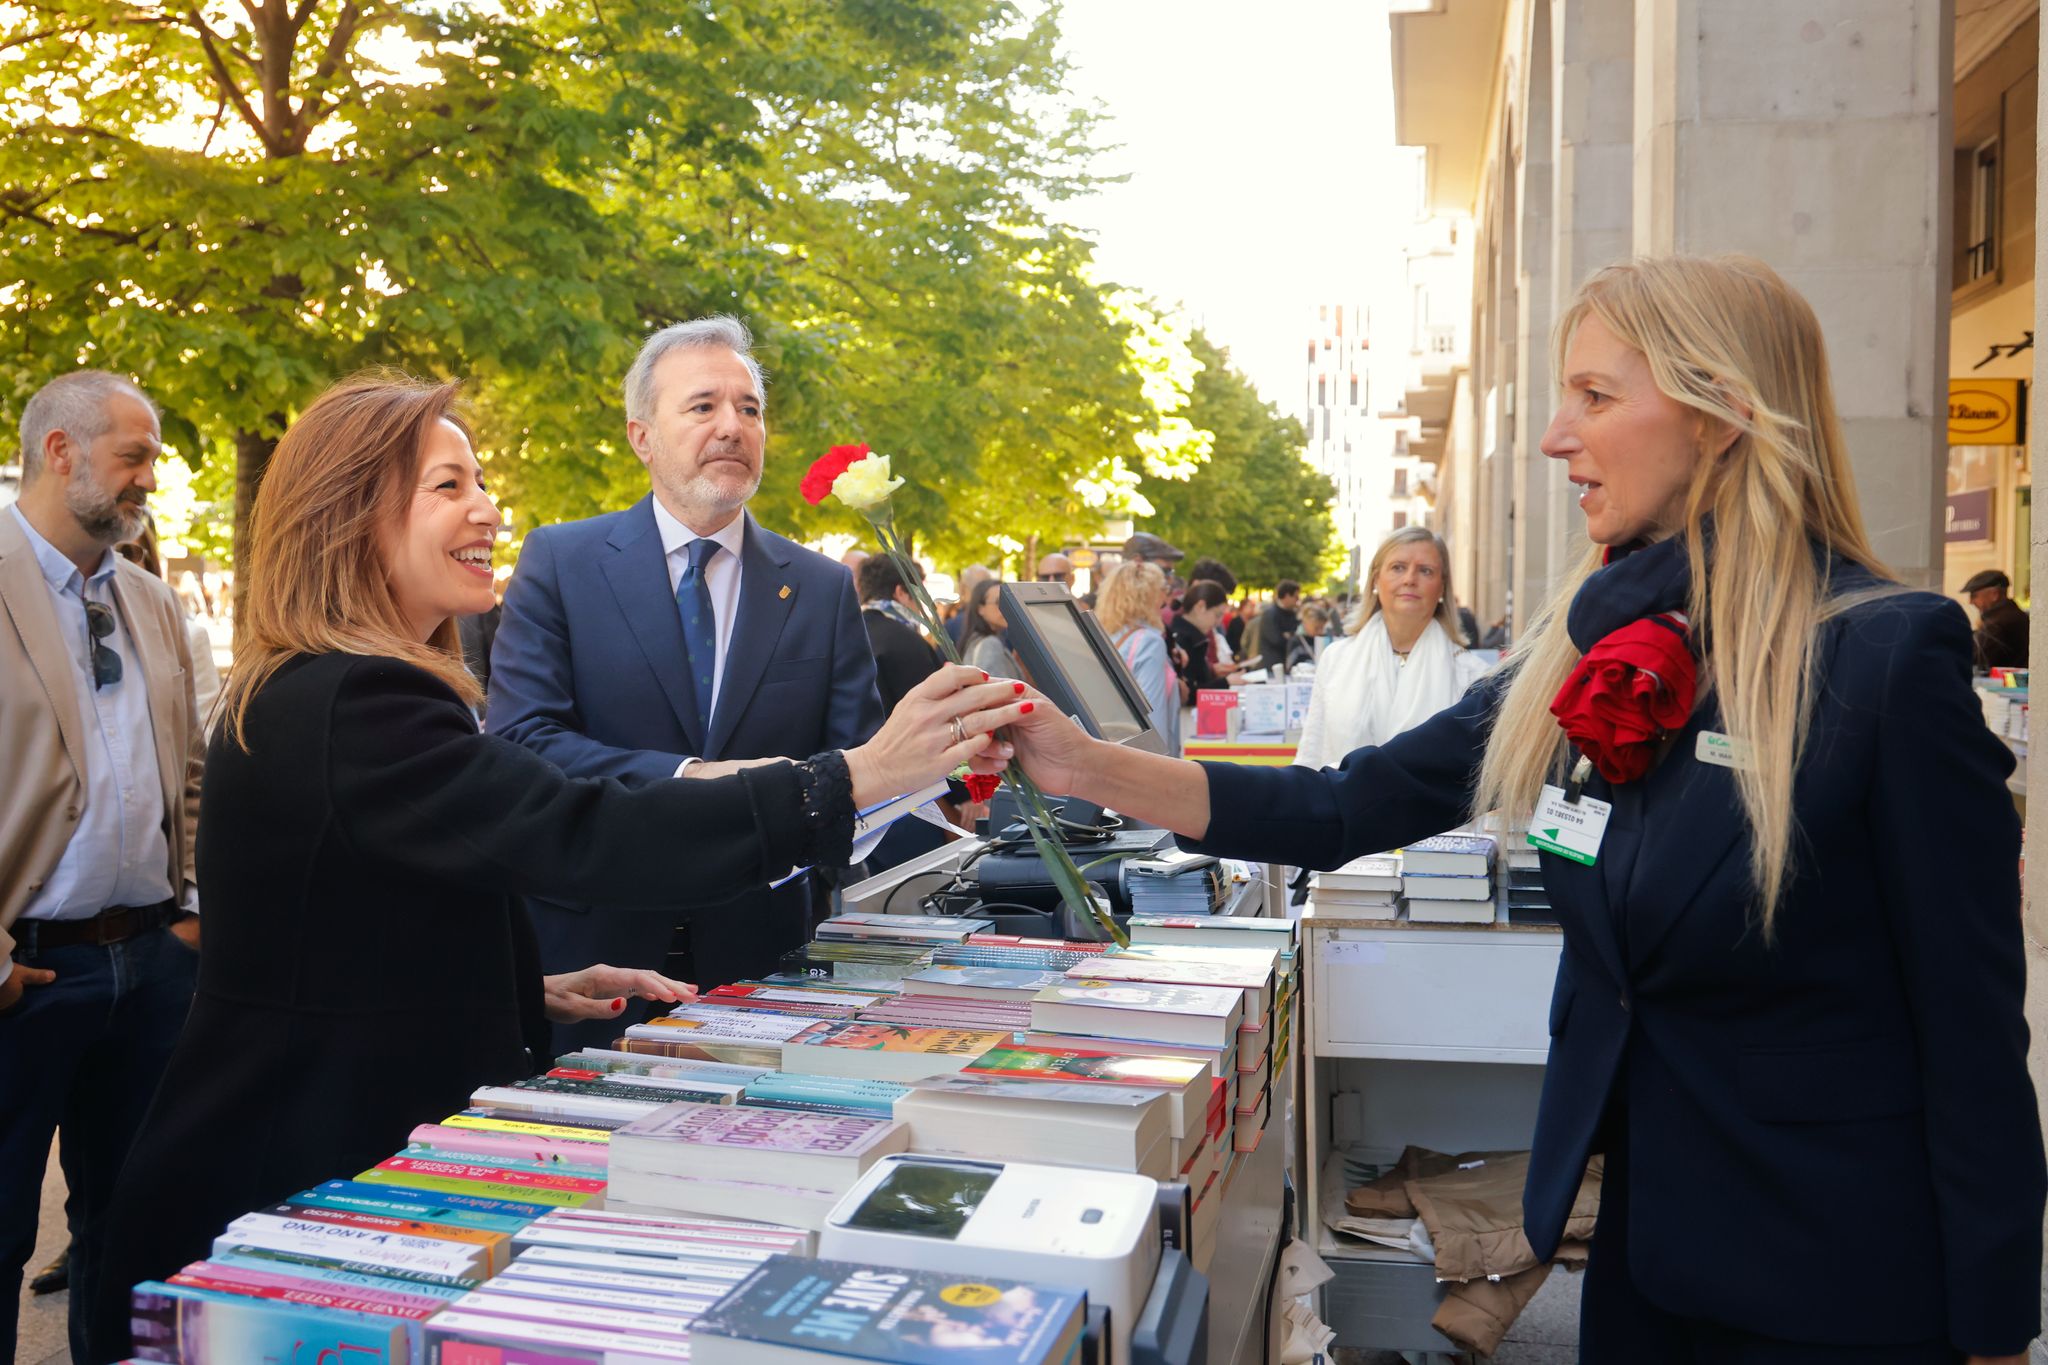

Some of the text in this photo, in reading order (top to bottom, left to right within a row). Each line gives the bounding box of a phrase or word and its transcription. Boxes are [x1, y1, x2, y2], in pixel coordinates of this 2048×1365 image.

[1200, 693, 1236, 701] INVICTO
[666, 1107, 724, 1135] HOOVER
[804, 1118, 881, 1151] ROMPER
[282, 1289, 422, 1318] DANIELLE STEEL
[822, 1270, 909, 1311] SAVE
[790, 1308, 871, 1341] ME
